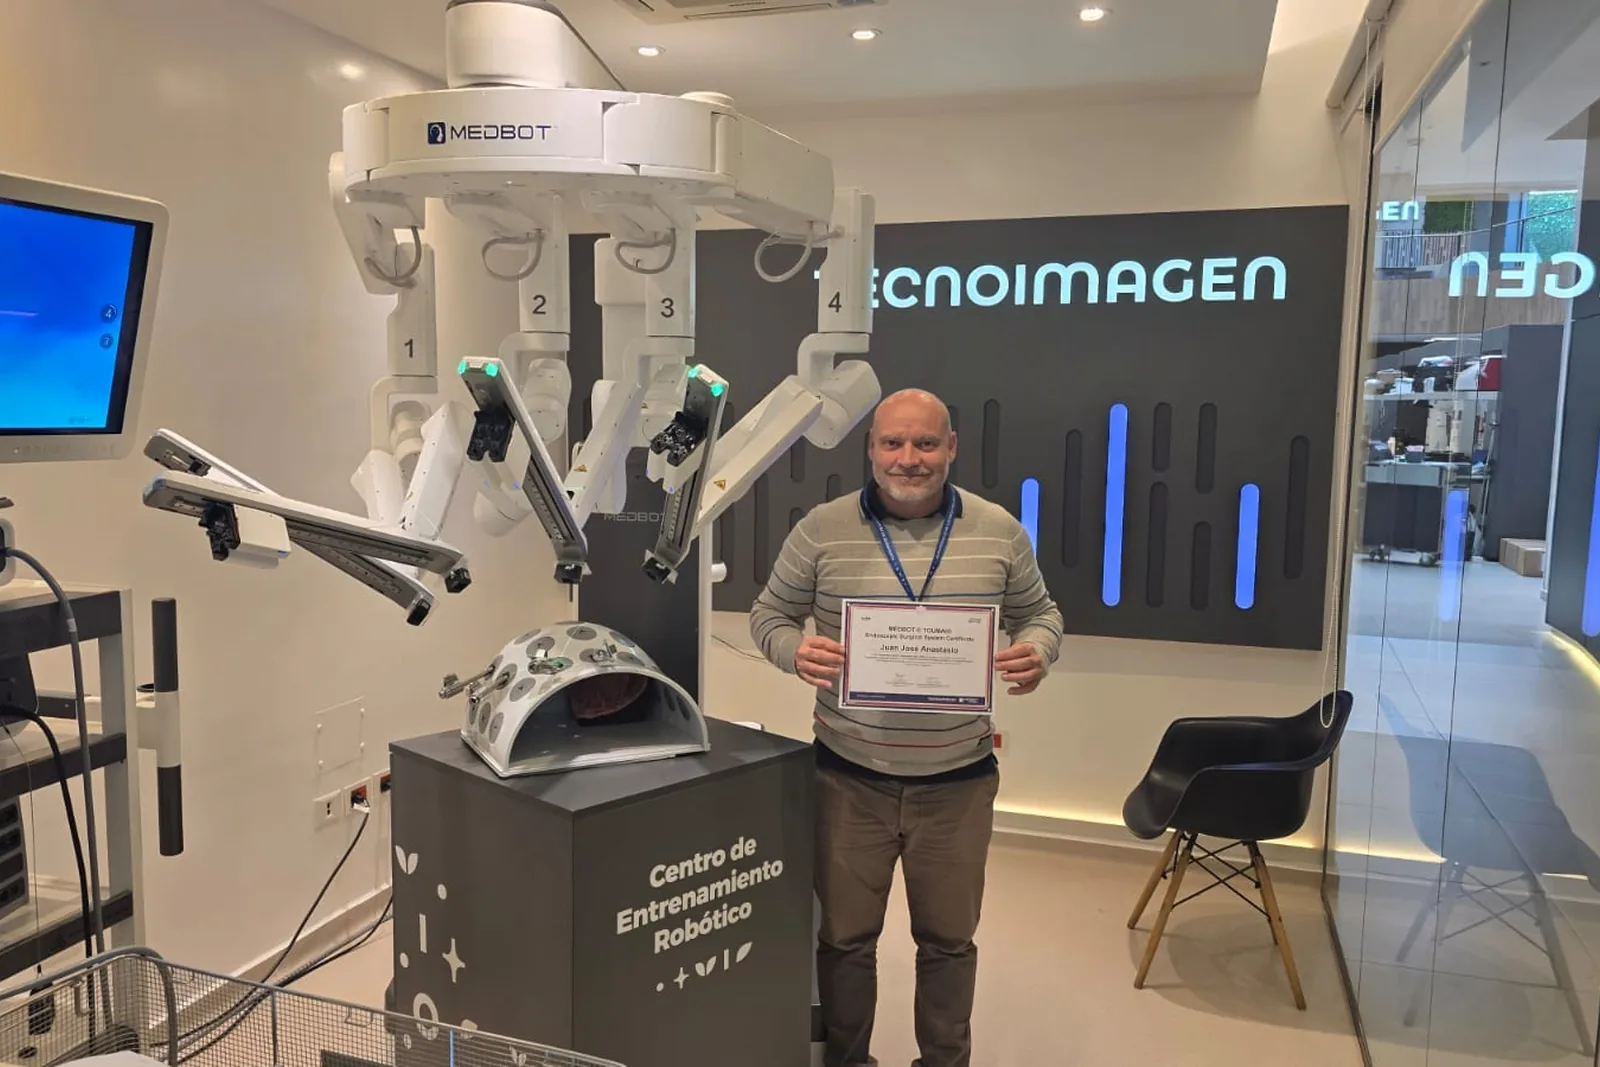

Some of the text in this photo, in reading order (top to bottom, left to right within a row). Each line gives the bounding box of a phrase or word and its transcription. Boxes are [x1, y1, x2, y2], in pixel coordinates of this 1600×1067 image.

[450, 124, 552, 140] MEDBOT
[814, 256, 1287, 308] CNOIMAGEN
[532, 294, 546, 315] 2
[660, 297, 675, 318] 3
[828, 292, 842, 313] 4
[404, 338, 414, 358] 1
[880, 643, 899, 652] Juan
[650, 836, 757, 888] Centro de
[616, 860, 784, 935] Entrenamiento
[653, 902, 753, 954] Robótico
